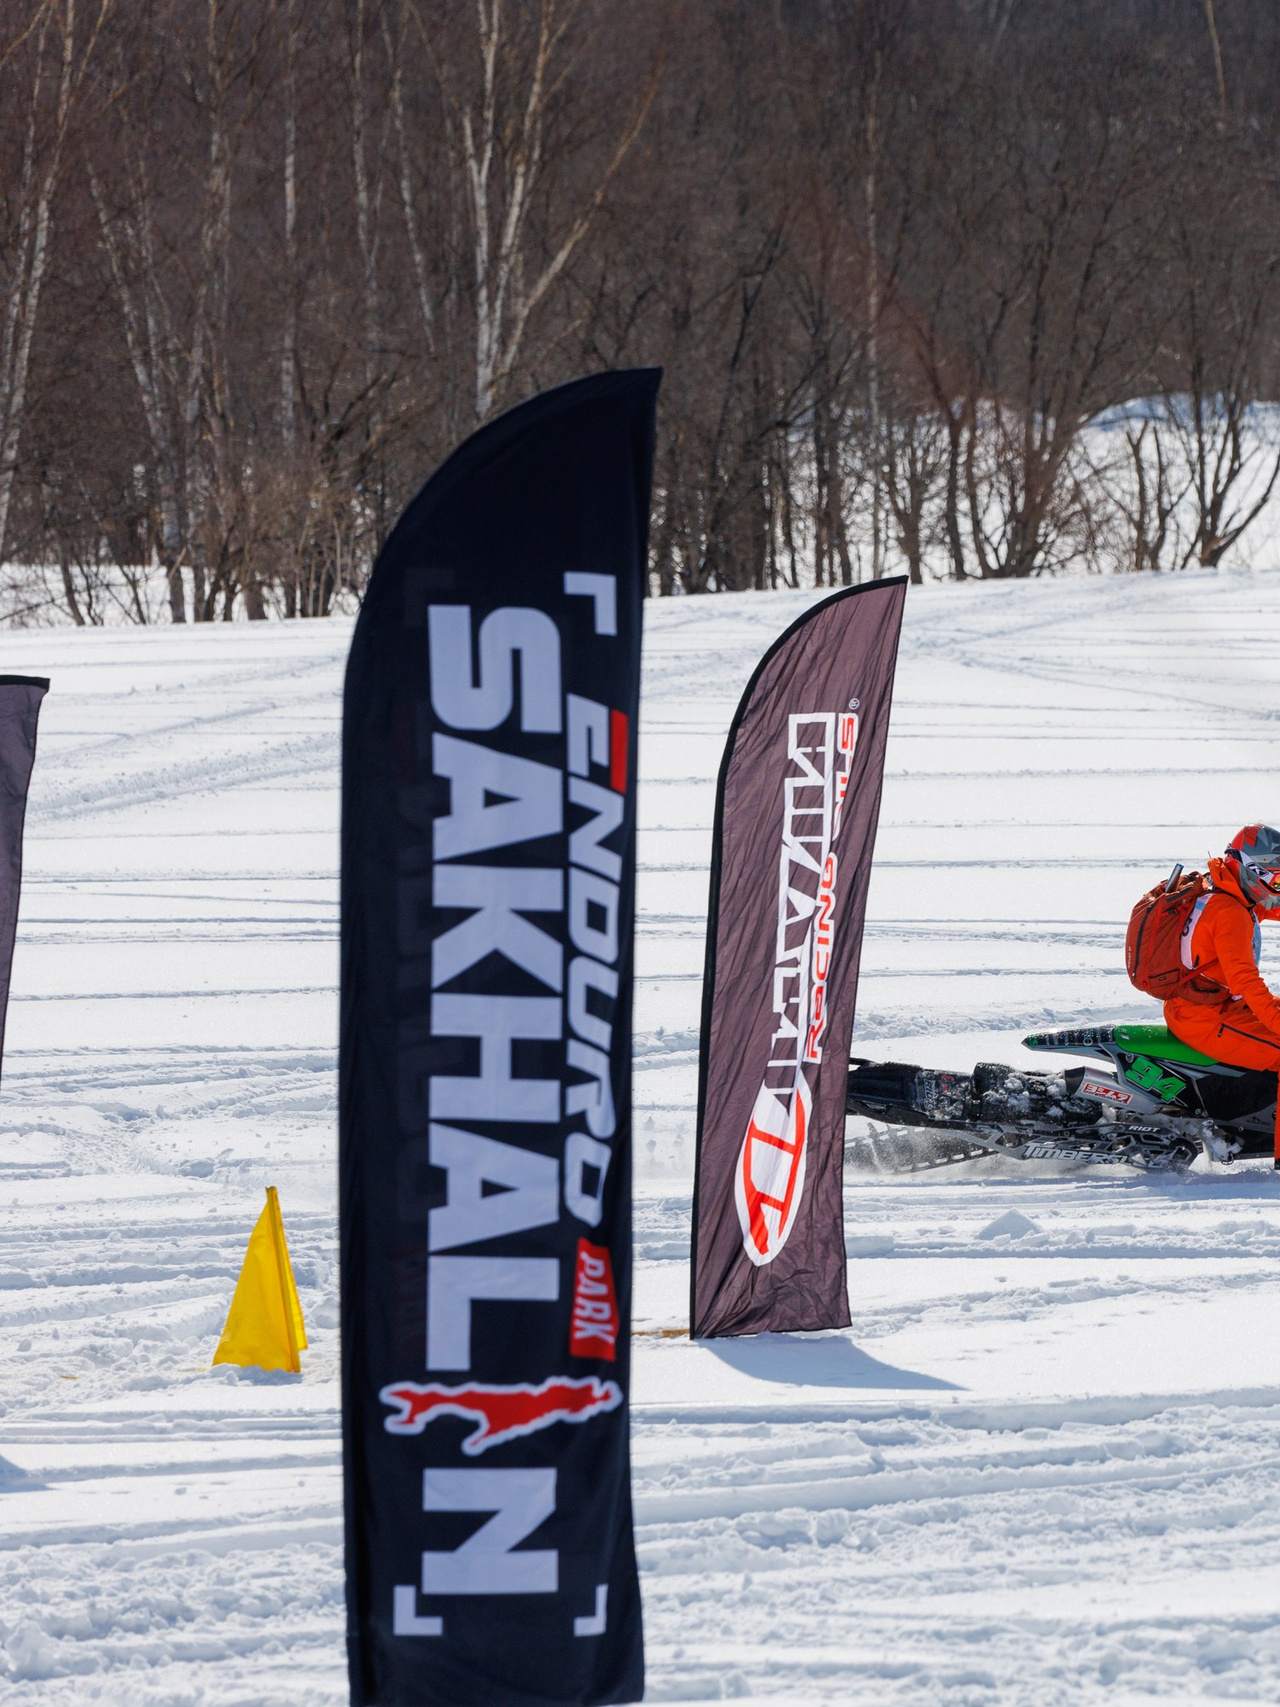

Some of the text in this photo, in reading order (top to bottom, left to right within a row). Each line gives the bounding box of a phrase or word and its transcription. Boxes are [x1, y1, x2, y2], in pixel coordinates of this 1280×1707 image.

[565, 692, 628, 1345] ENDURO PARK
[1124, 1056, 1187, 1103] 94
[1128, 1125, 1160, 1133] RIOT
